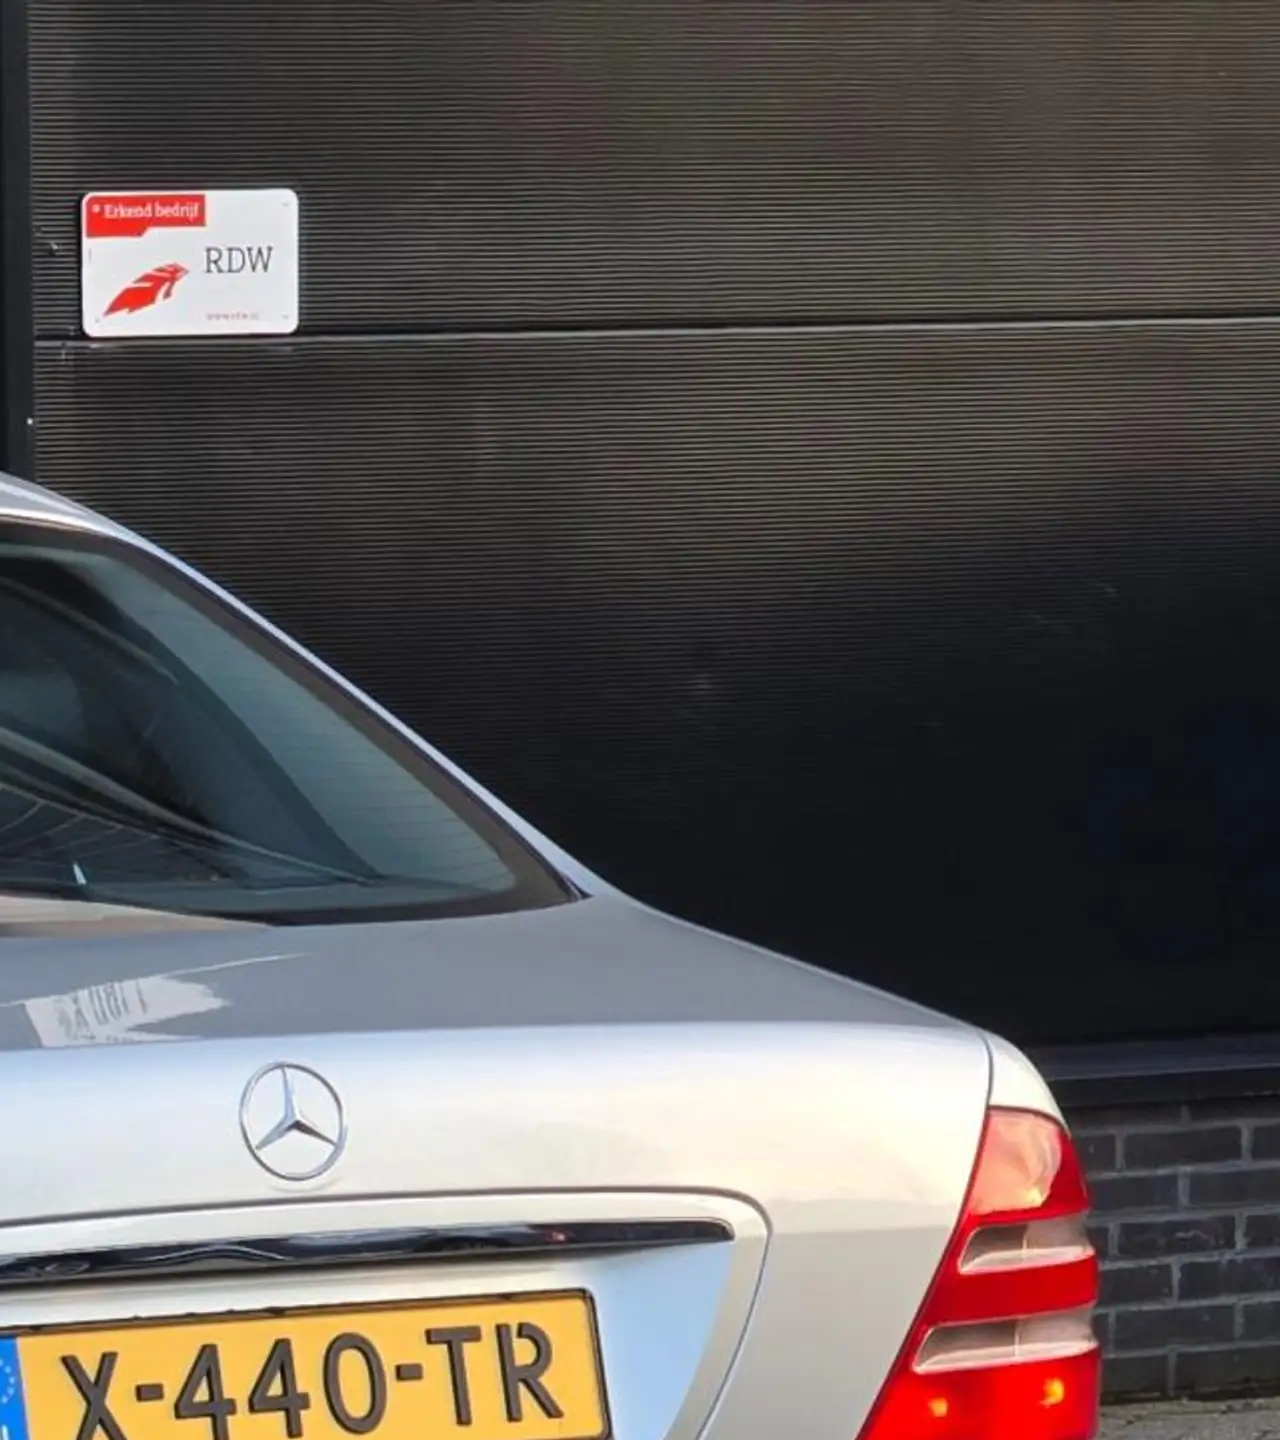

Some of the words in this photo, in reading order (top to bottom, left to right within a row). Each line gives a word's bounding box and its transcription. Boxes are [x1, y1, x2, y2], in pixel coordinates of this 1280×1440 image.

[104, 202, 152, 219] Erkend
[154, 200, 200, 223] bedrijf
[205, 245, 274, 274] RDW
